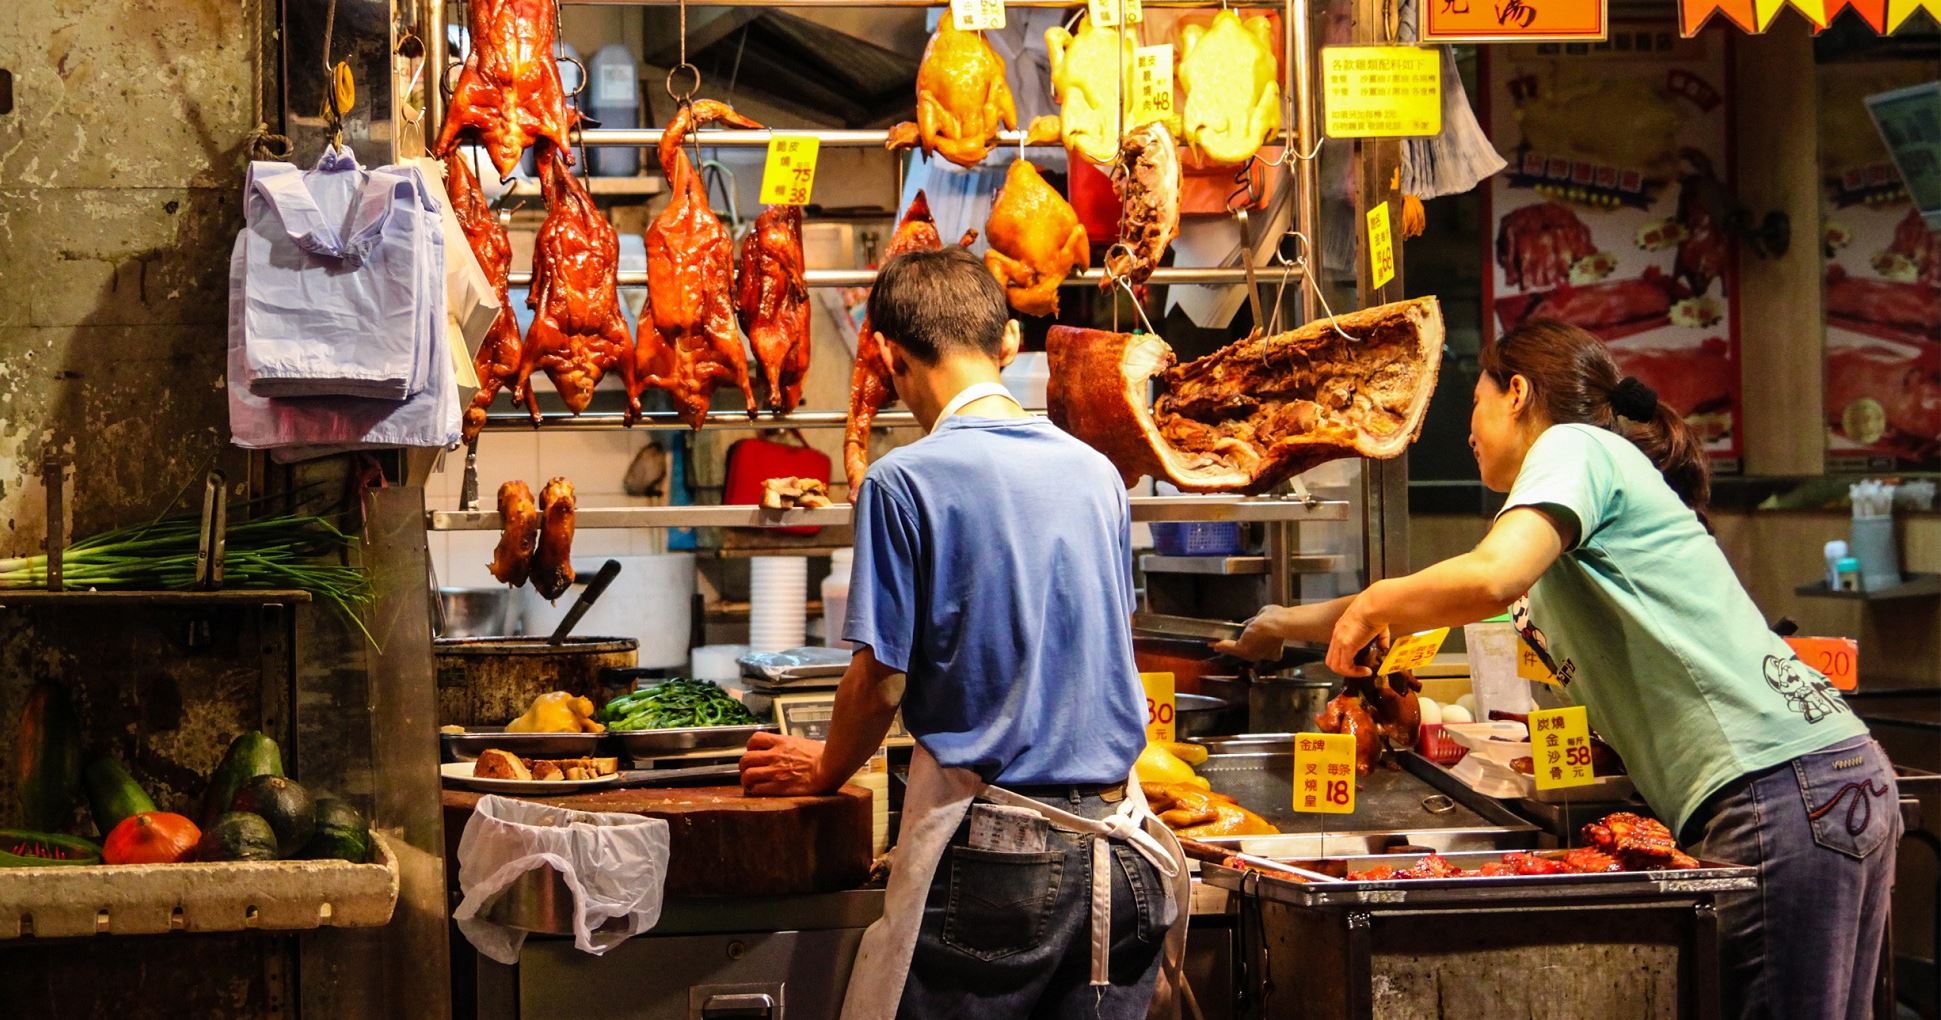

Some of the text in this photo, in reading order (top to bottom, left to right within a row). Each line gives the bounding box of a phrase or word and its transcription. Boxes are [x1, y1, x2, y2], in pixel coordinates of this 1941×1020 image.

[1153, 91, 1170, 111] 48
[793, 168, 812, 182] 75
[789, 187, 807, 203] 38
[1819, 651, 1849, 676] 20
[1537, 716, 1565, 731] 炭燒
[1156, 729, 1168, 740] 元
[1300, 739, 1325, 752] 金牌
[1566, 746, 1591, 766] 58
[1572, 766, 1585, 778] 元
[1326, 780, 1350, 805] 18
